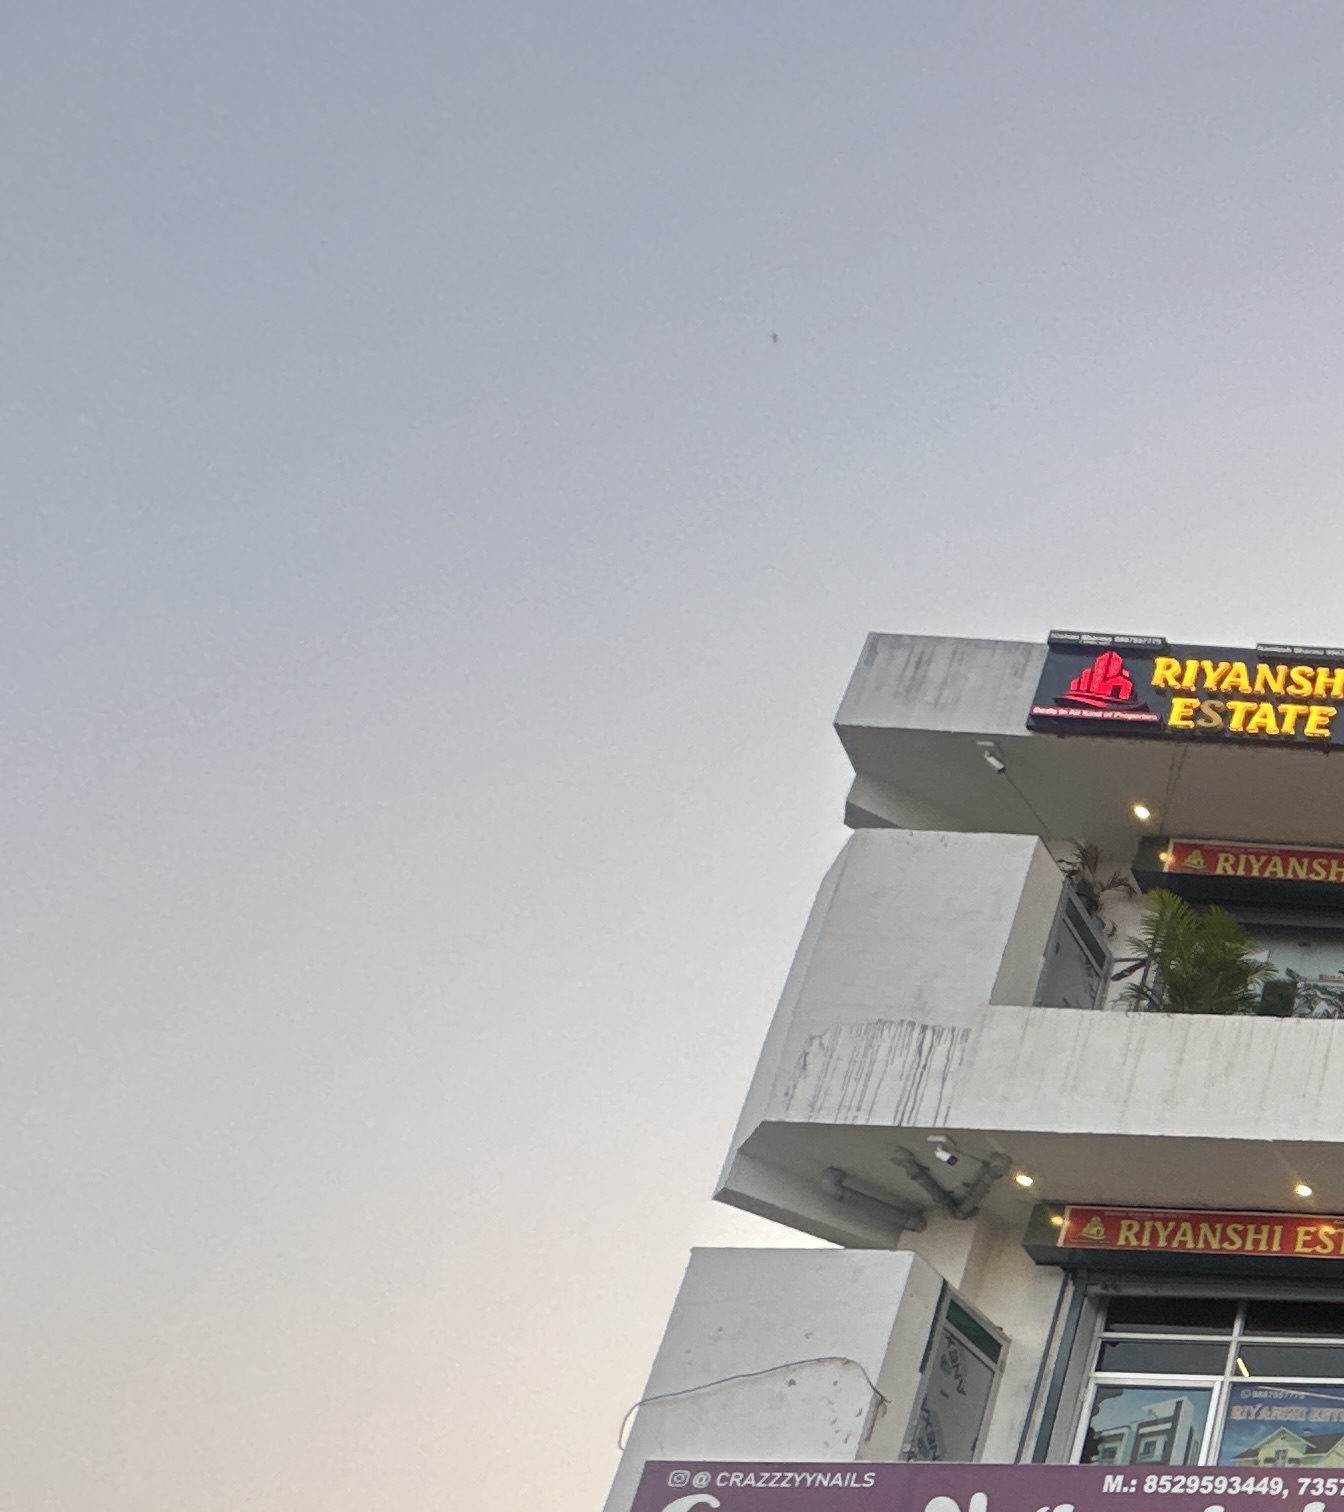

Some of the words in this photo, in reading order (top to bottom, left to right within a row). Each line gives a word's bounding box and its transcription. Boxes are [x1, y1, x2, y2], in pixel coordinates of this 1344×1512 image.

[1168, 697, 1336, 737] ESTATE
[1117, 1219, 1282, 1252] RIYANSHI
[716, 1472, 876, 1488] CRAZZZYYNAILS
[1143, 1475, 1289, 1498] 8529593449,
